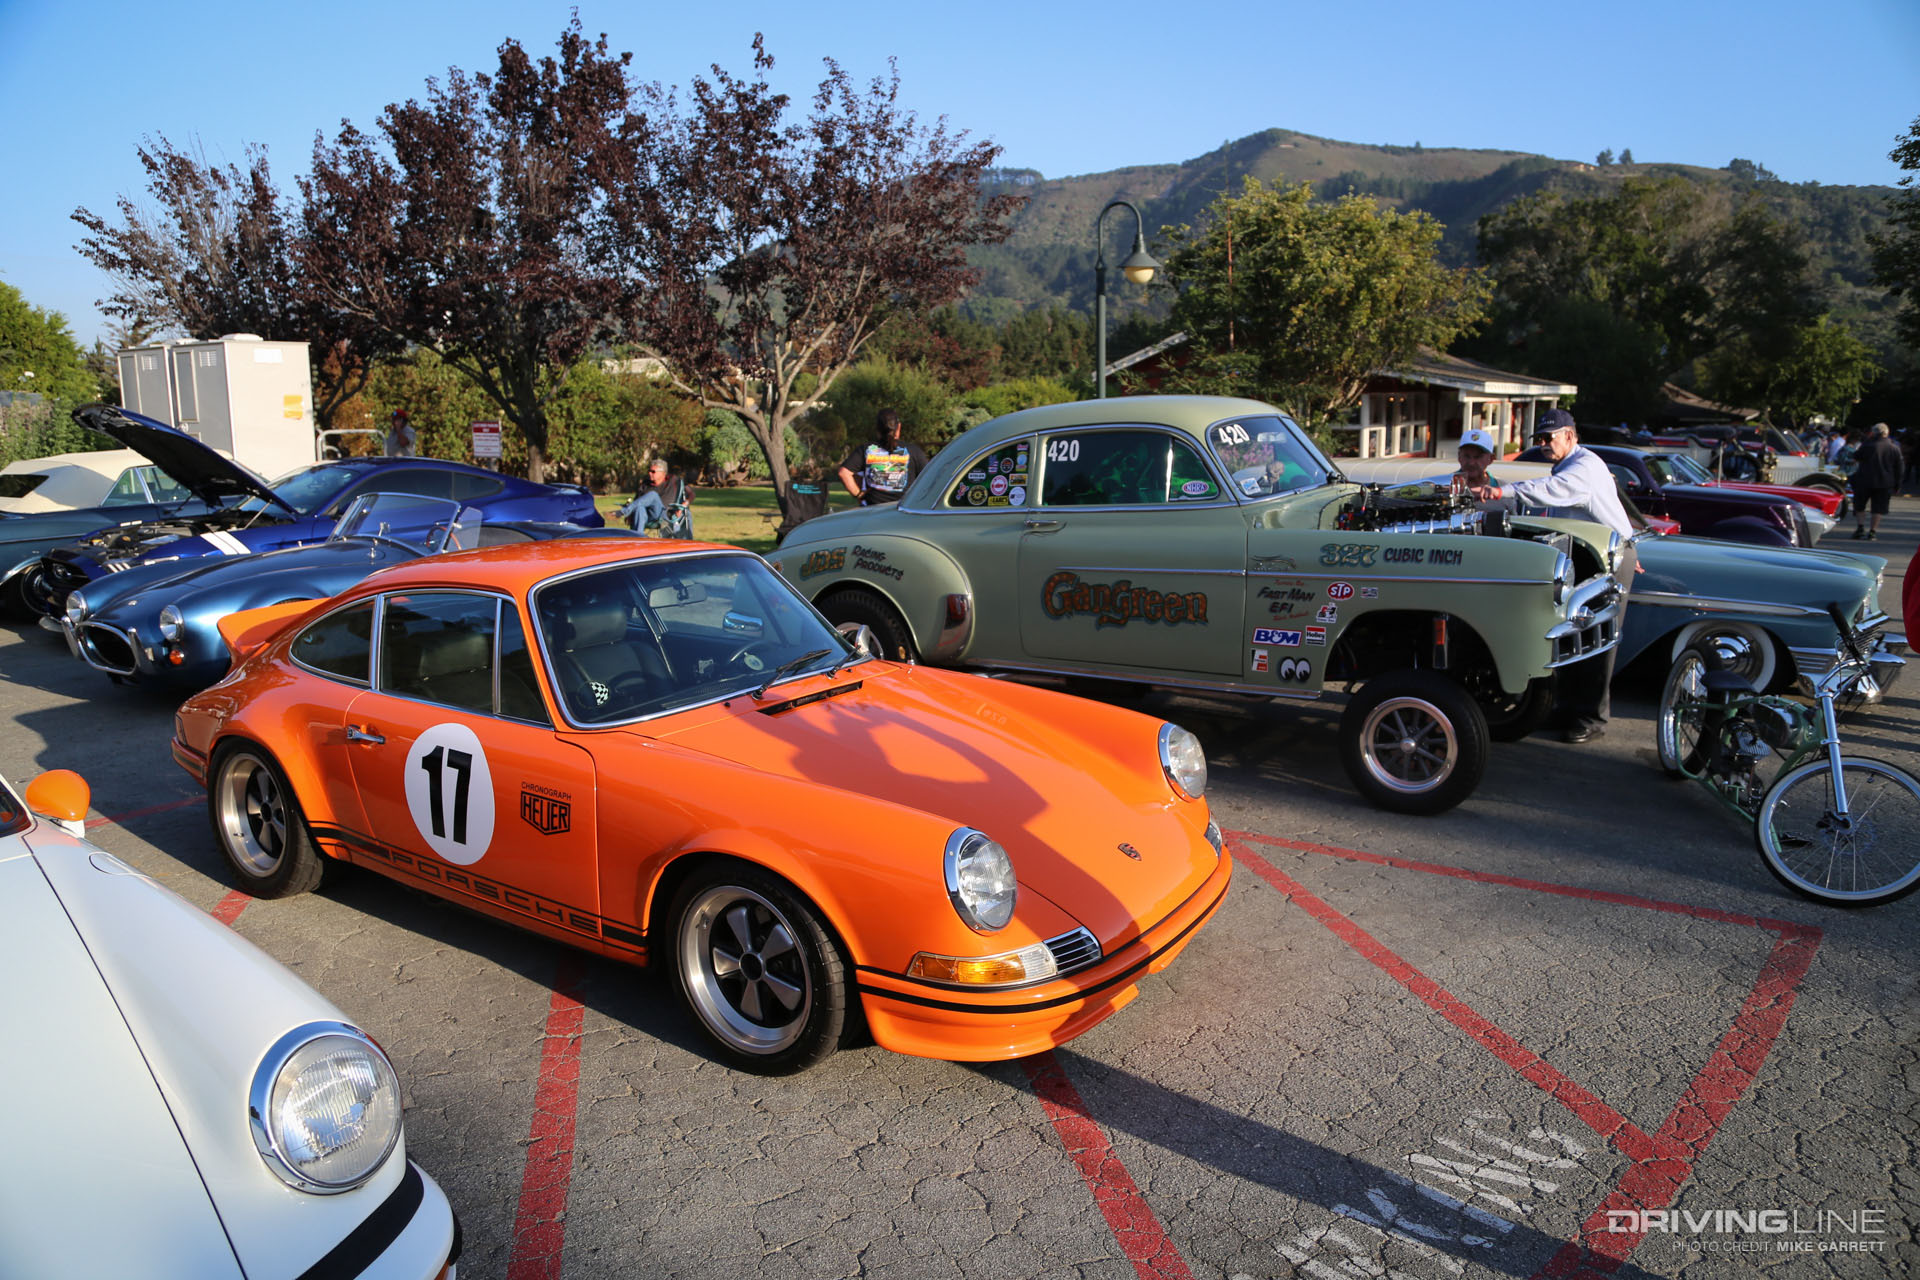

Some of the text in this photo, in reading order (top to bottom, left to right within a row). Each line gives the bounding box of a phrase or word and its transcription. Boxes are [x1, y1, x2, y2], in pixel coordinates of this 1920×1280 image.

[1218, 423, 1250, 446] 420
[1047, 439, 1080, 462] 420
[1185, 483, 1206, 493] NHRA
[800, 547, 847, 581] JDS
[1320, 543, 1380, 568] 327
[1384, 547, 1463, 565] CUBIC INCH
[1330, 584, 1352, 597] STP
[1269, 601, 1294, 613] EFI
[1255, 629, 1301, 645] B&M
[1306, 632, 1325, 640] Holley
[421, 745, 472, 845] 17
[521, 781, 572, 800] CHRONOGRAPH
[523, 795, 569, 832] HEUER
[393, 850, 599, 934] PORSCHE
